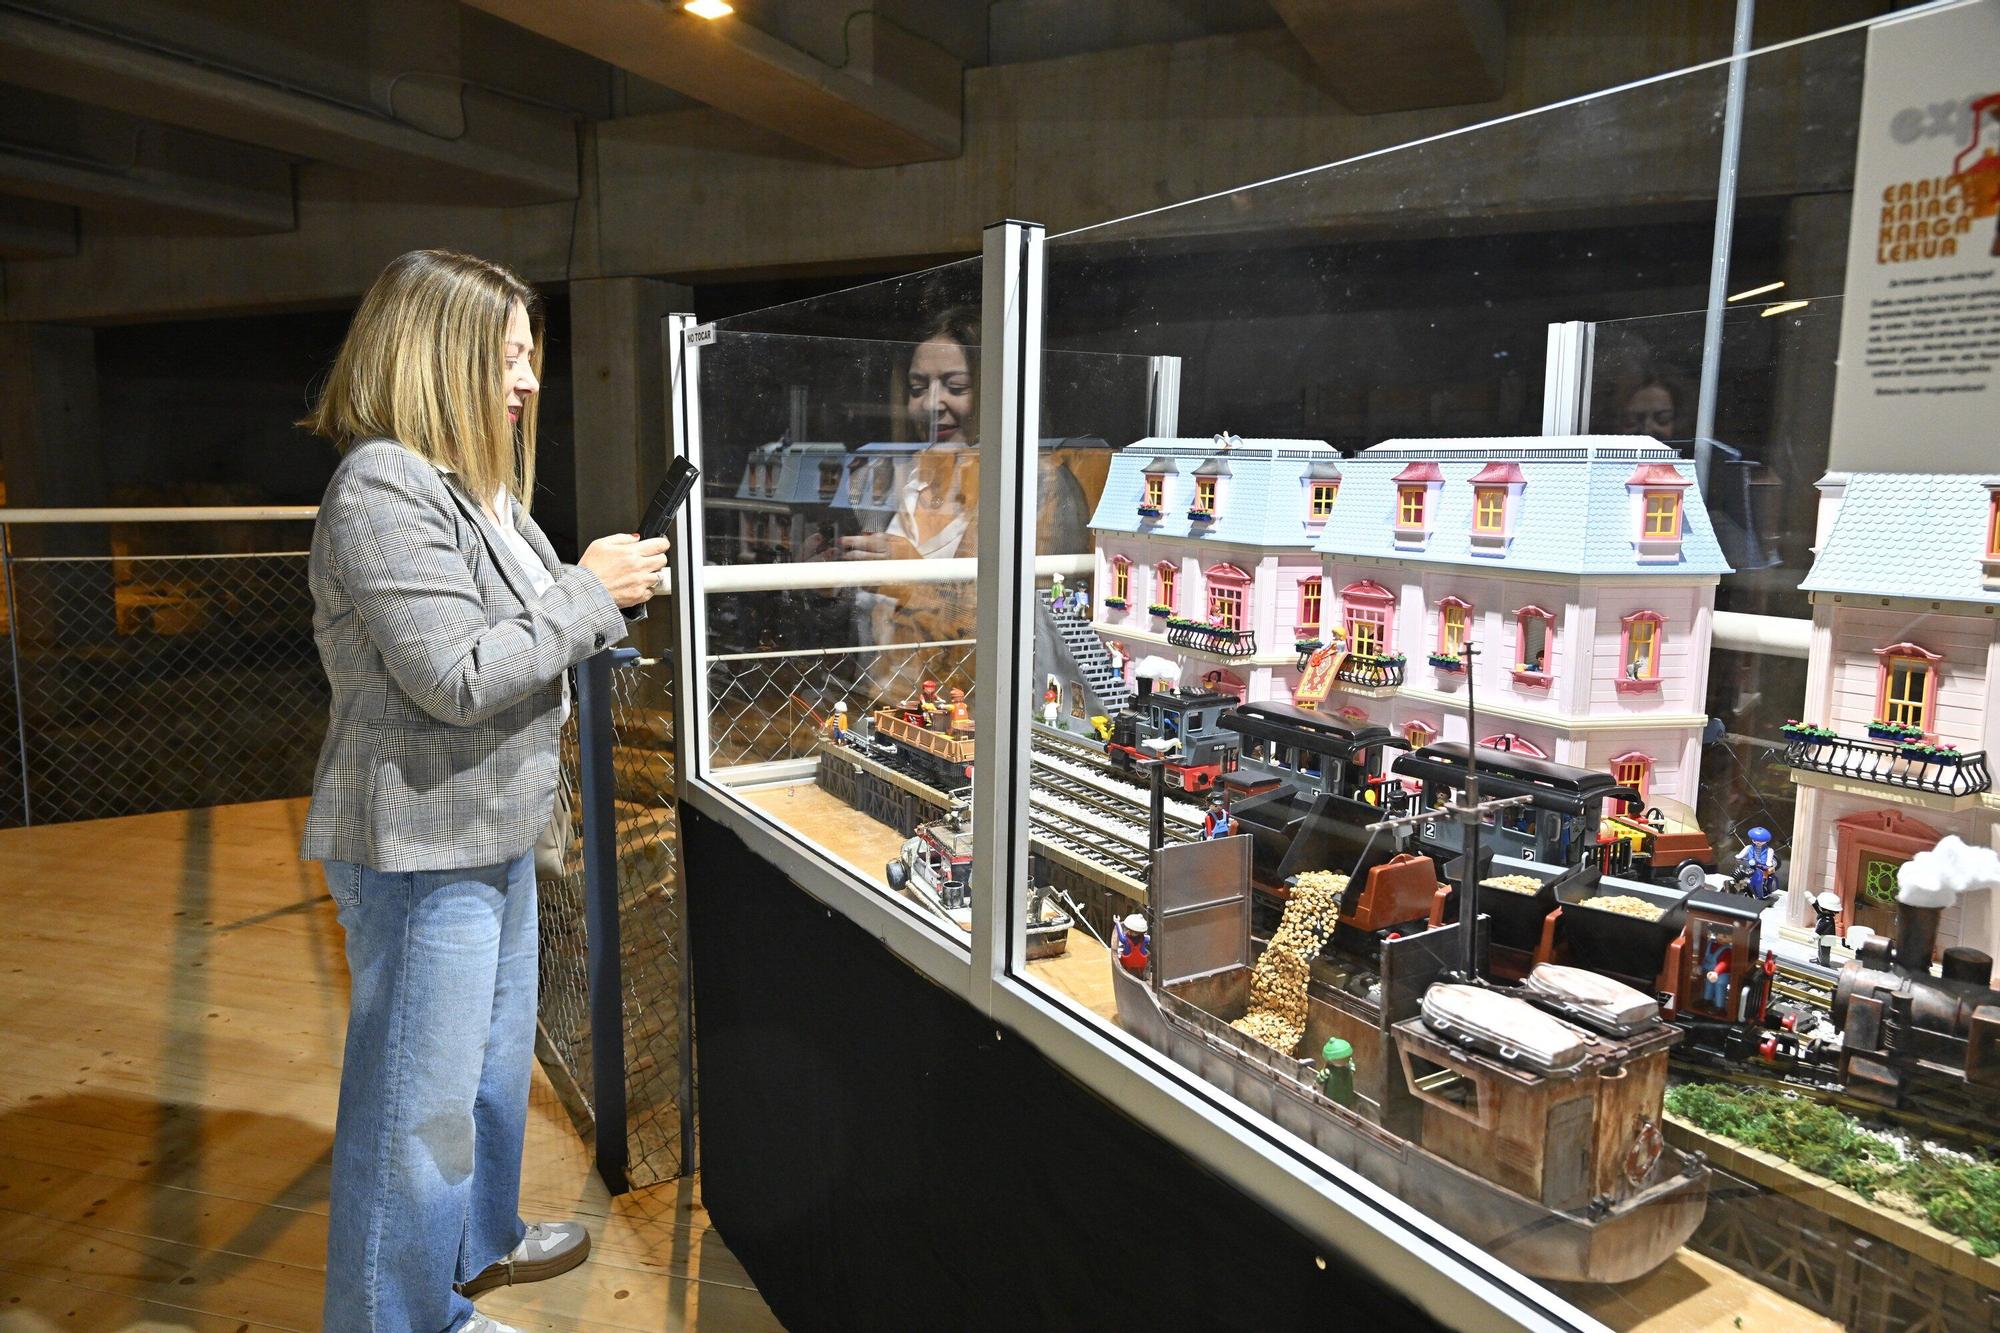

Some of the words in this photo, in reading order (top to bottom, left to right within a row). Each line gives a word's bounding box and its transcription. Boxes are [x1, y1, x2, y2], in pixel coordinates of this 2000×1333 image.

[1879, 215, 1969, 244] KARGA
[1876, 238, 1956, 265] LEKUA
[695, 330, 711, 341] TOCAR
[1426, 824, 1434, 836] 2
